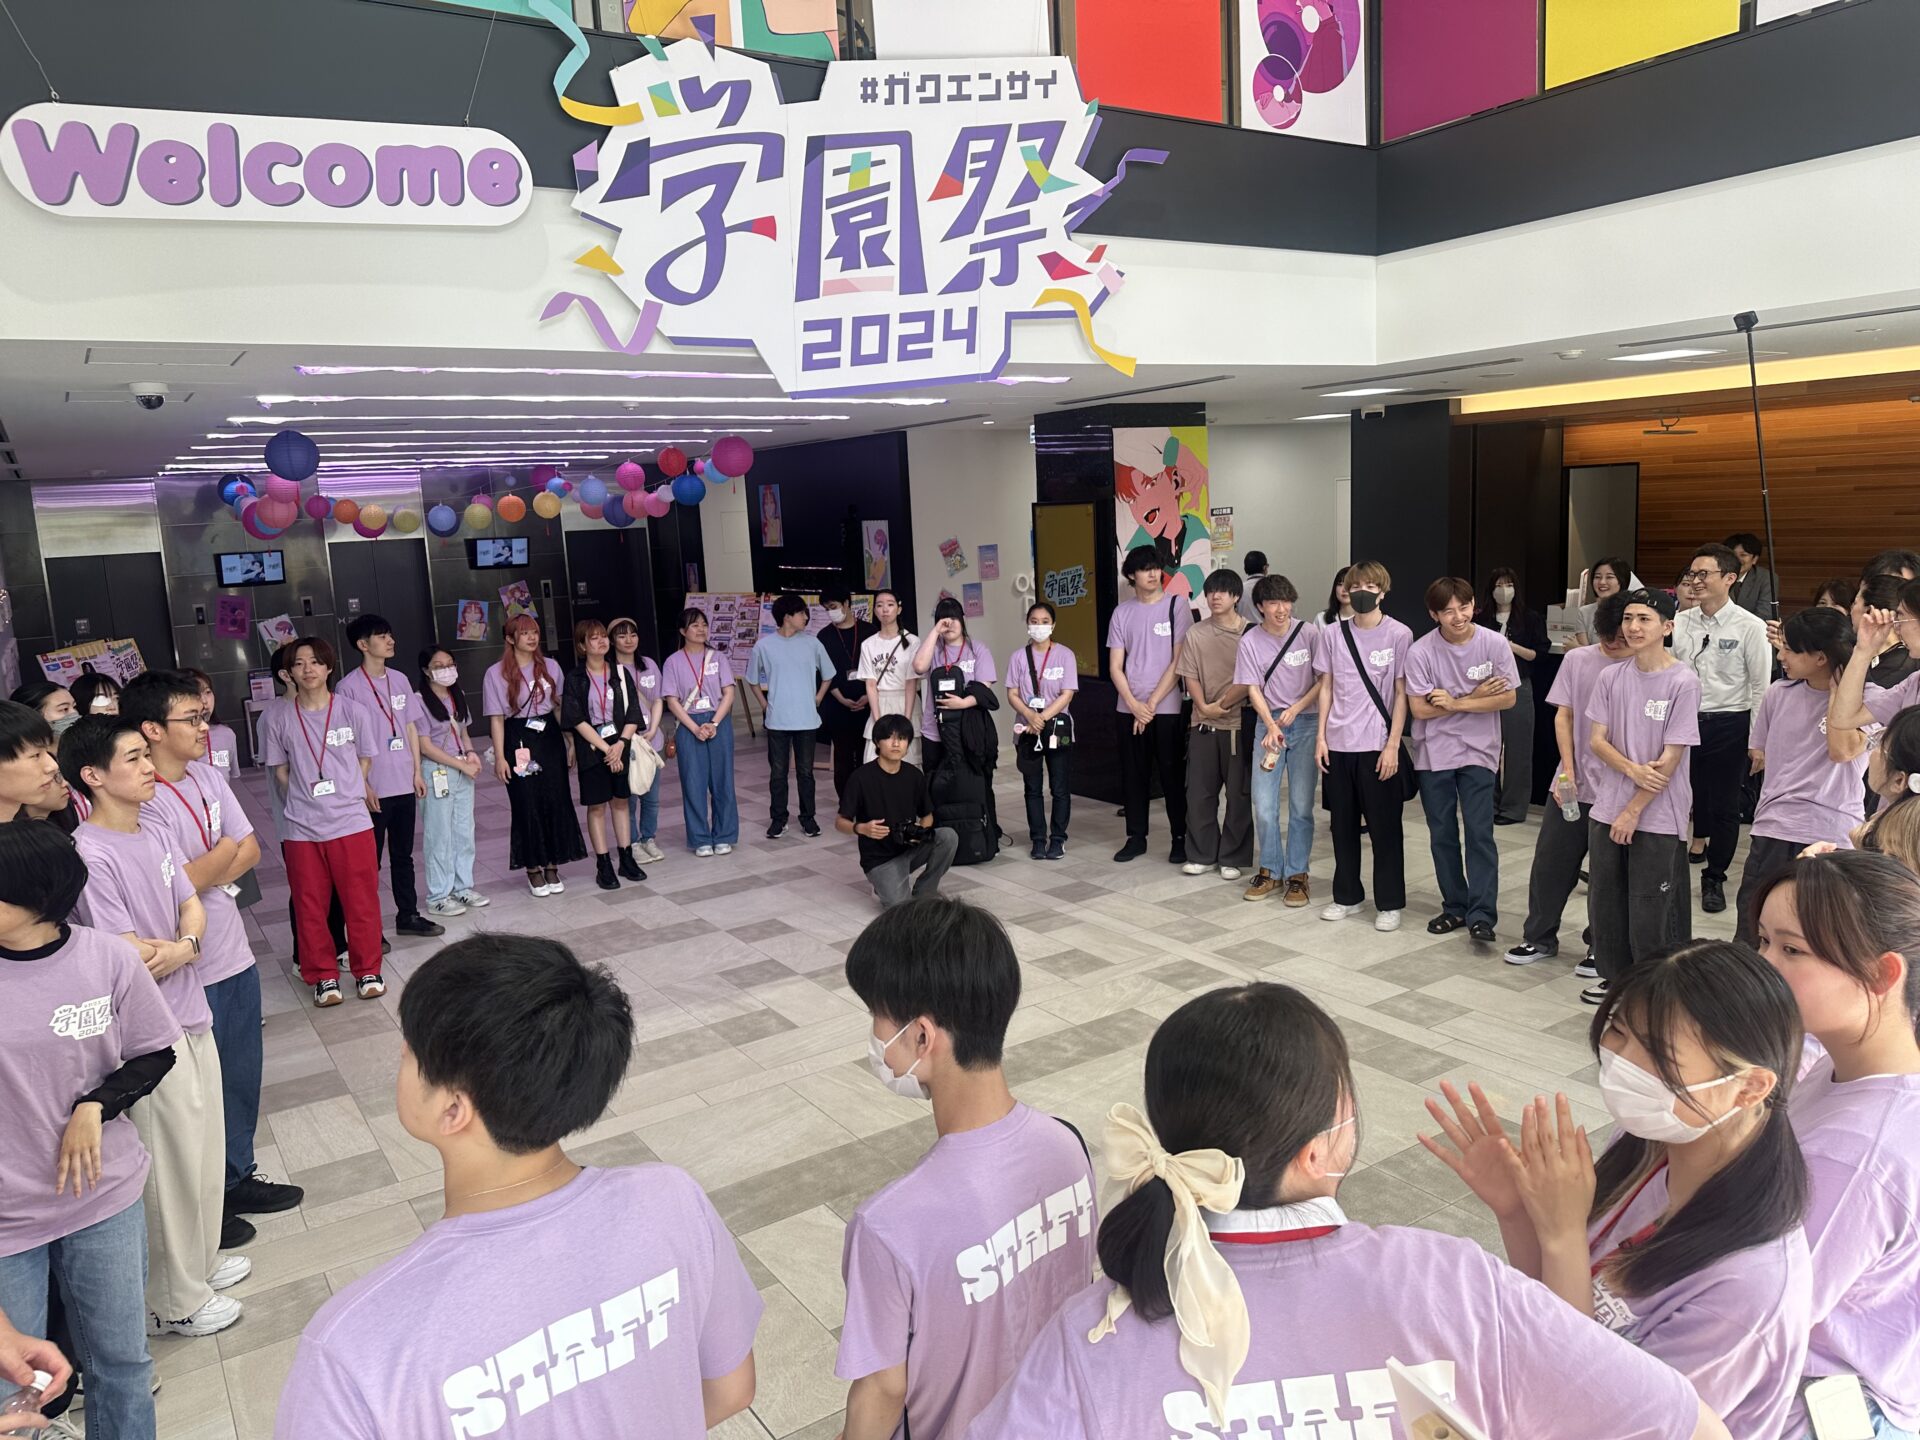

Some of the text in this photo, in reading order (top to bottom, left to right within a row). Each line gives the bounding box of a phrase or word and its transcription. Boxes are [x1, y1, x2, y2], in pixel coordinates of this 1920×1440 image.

[860, 70, 1058, 105] #ガクエンサイ
[11, 119, 523, 207] Welcome
[599, 75, 1070, 306] 学園祭
[802, 306, 978, 371] 2024
[1045, 573, 1082, 598] 学園祭
[1058, 597, 1075, 605] 2024
[78, 1026, 103, 1037] 2024
[443, 1267, 680, 1440] STAFF
